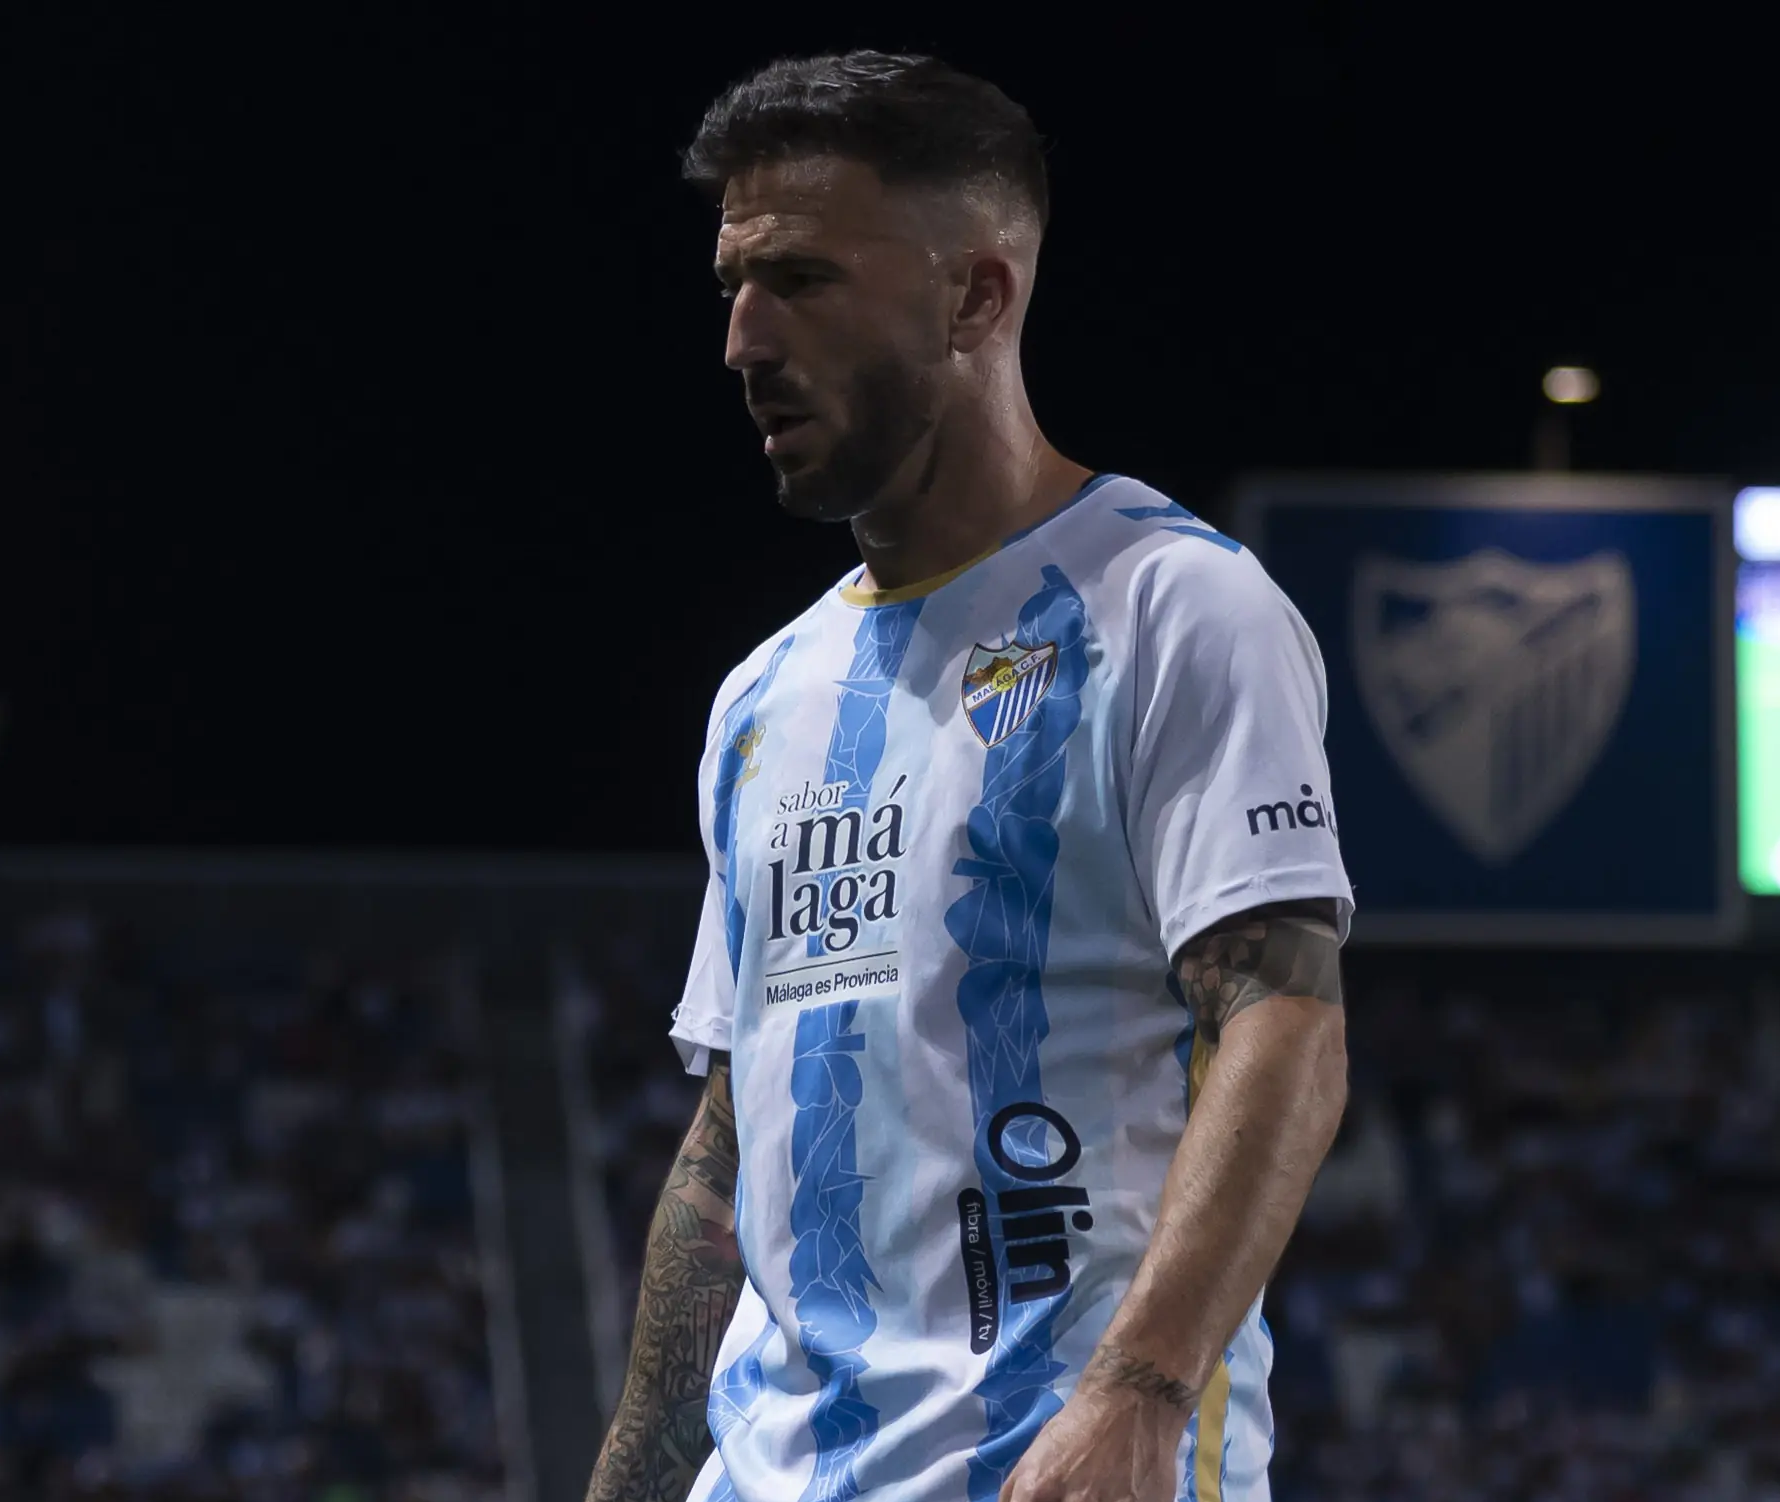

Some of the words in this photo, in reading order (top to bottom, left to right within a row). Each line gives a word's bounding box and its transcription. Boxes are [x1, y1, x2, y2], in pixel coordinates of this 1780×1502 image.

[777, 781, 846, 815] sabor
[770, 821, 788, 849] a
[792, 774, 907, 874] má
[767, 859, 899, 952] laga
[766, 982, 812, 1006] Málaga
[815, 979, 832, 995] es
[833, 964, 899, 991] Provincia
[966, 1201, 981, 1244] fibra
[987, 1101, 1094, 1305] Olin
[972, 1260, 993, 1309] móvil
[978, 1323, 993, 1341] tv
